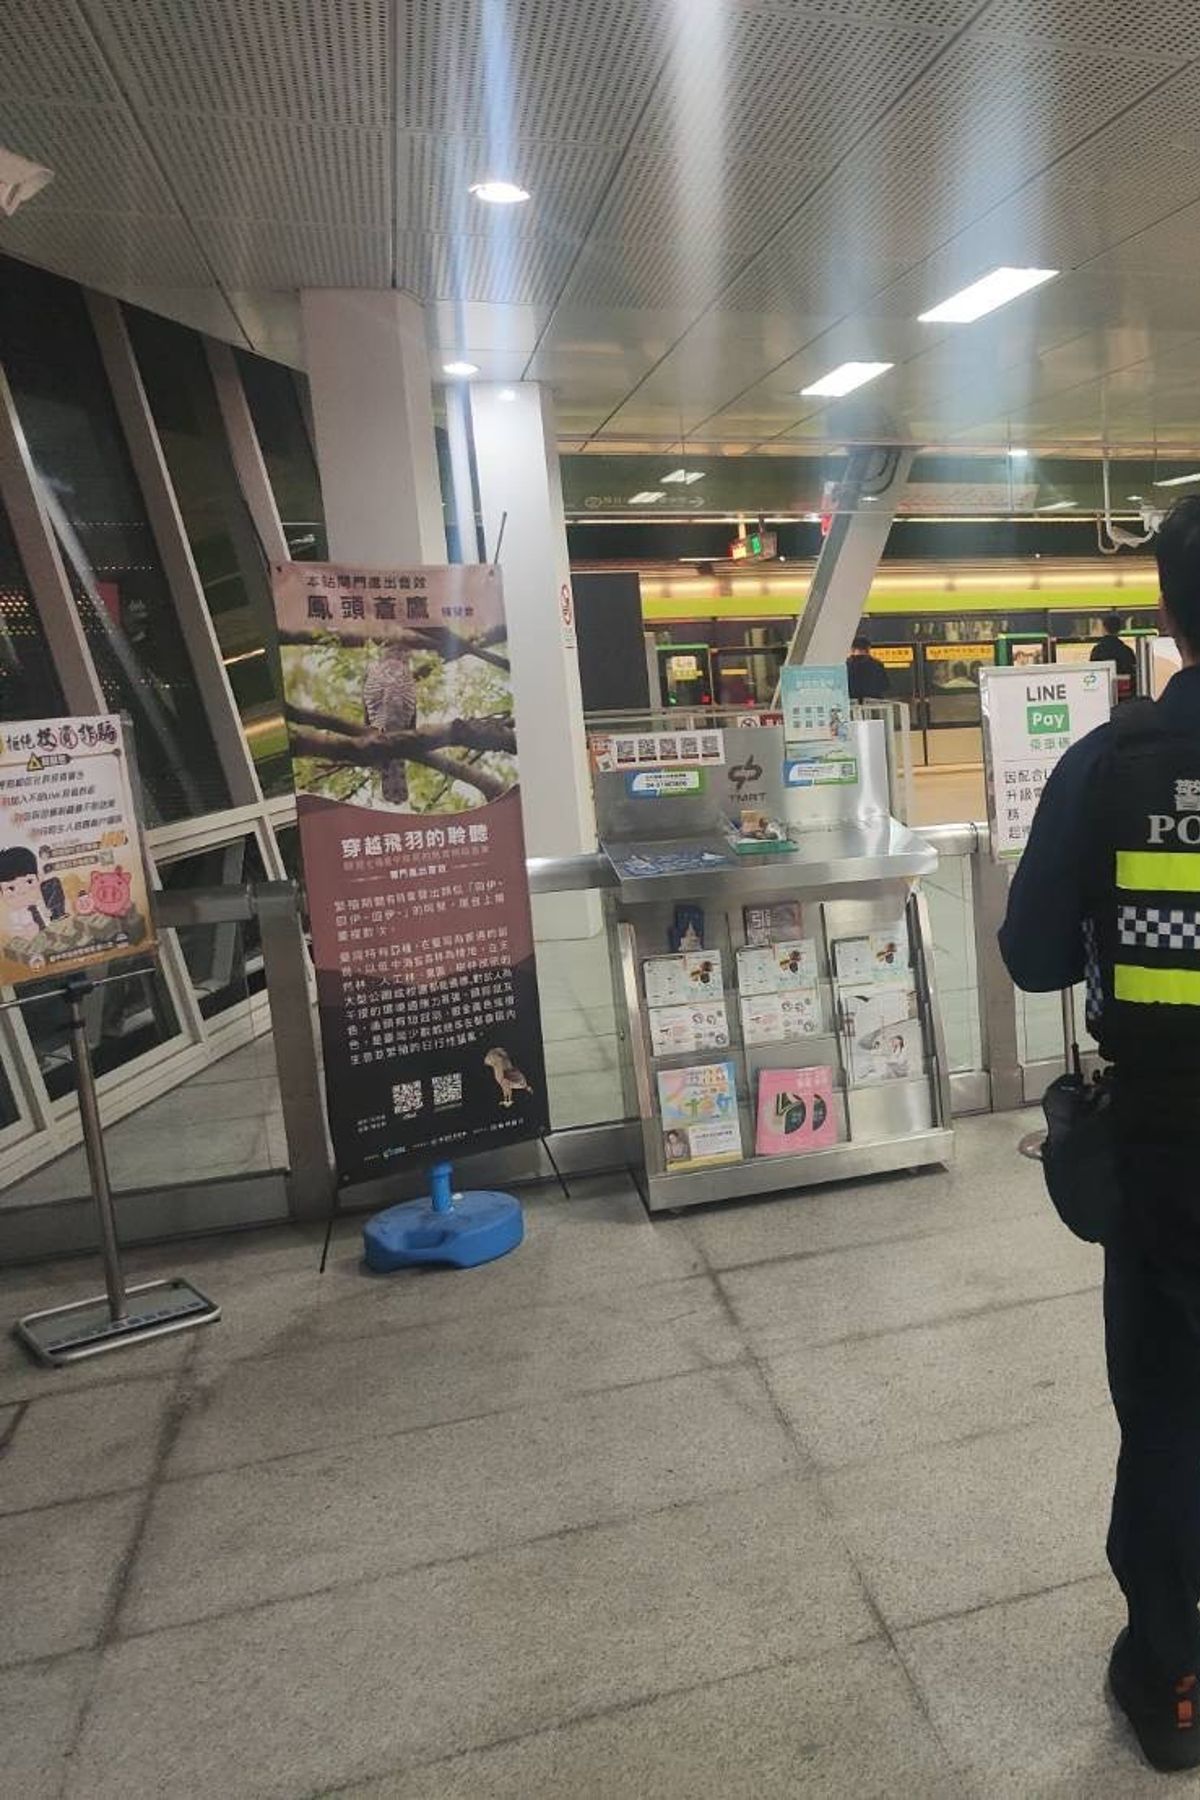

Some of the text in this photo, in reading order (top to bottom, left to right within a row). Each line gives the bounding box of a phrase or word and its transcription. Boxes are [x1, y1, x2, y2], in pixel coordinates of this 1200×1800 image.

[306, 595, 430, 621] 鳳頭蒼鷹
[1026, 684, 1067, 702] LINE
[1032, 709, 1065, 729] Pay
[341, 824, 489, 859] 穿越飛羽的聆聽
